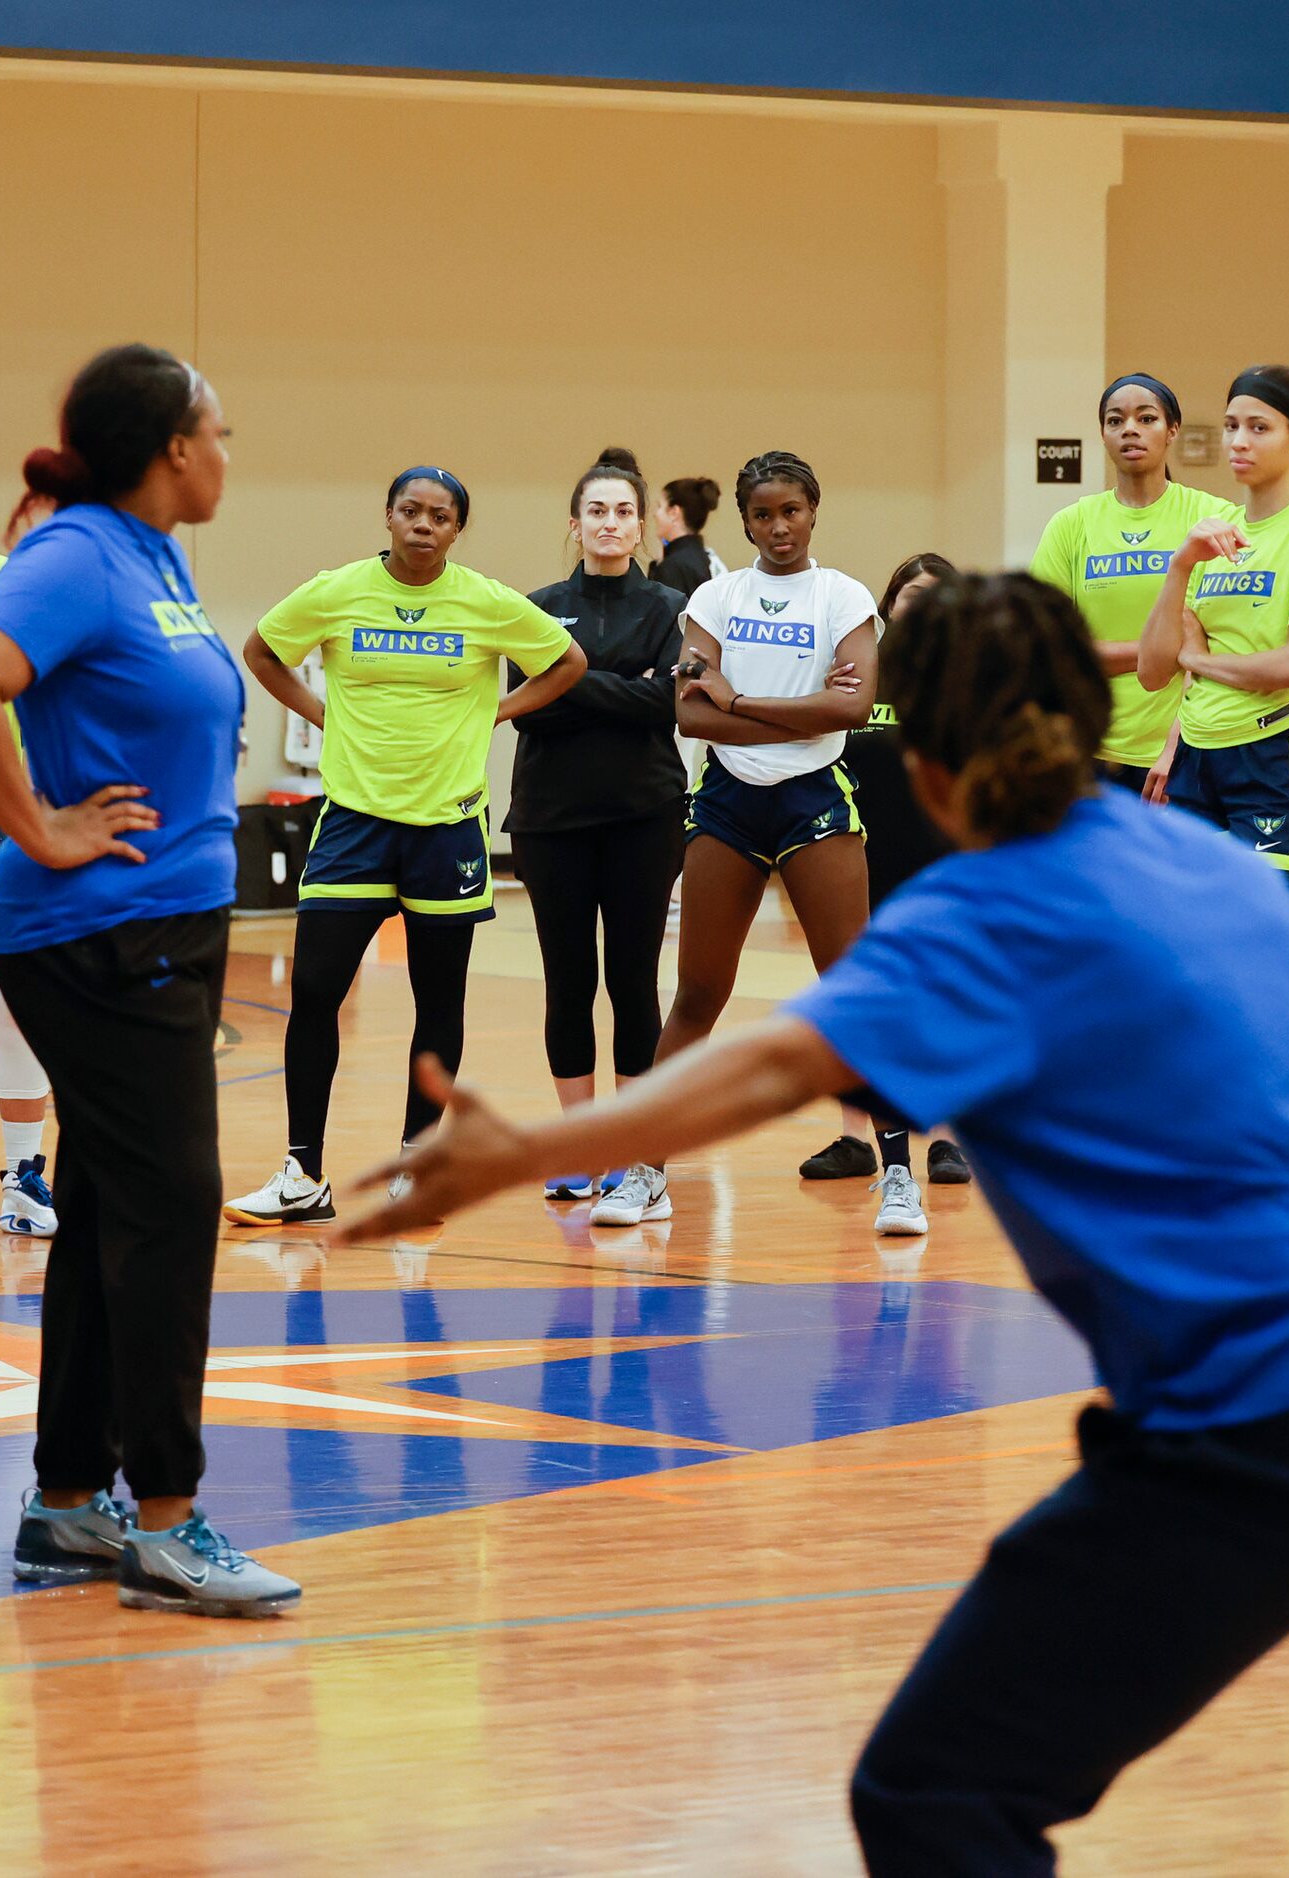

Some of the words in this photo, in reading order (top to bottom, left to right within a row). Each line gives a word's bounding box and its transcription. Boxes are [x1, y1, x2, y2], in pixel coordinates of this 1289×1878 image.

[1039, 446, 1080, 459] COURT
[1055, 466, 1064, 479] 2
[1091, 554, 1174, 575] WING
[1201, 574, 1265, 593] WINGS
[727, 619, 810, 644] WINGS
[361, 632, 456, 653] WINGS
